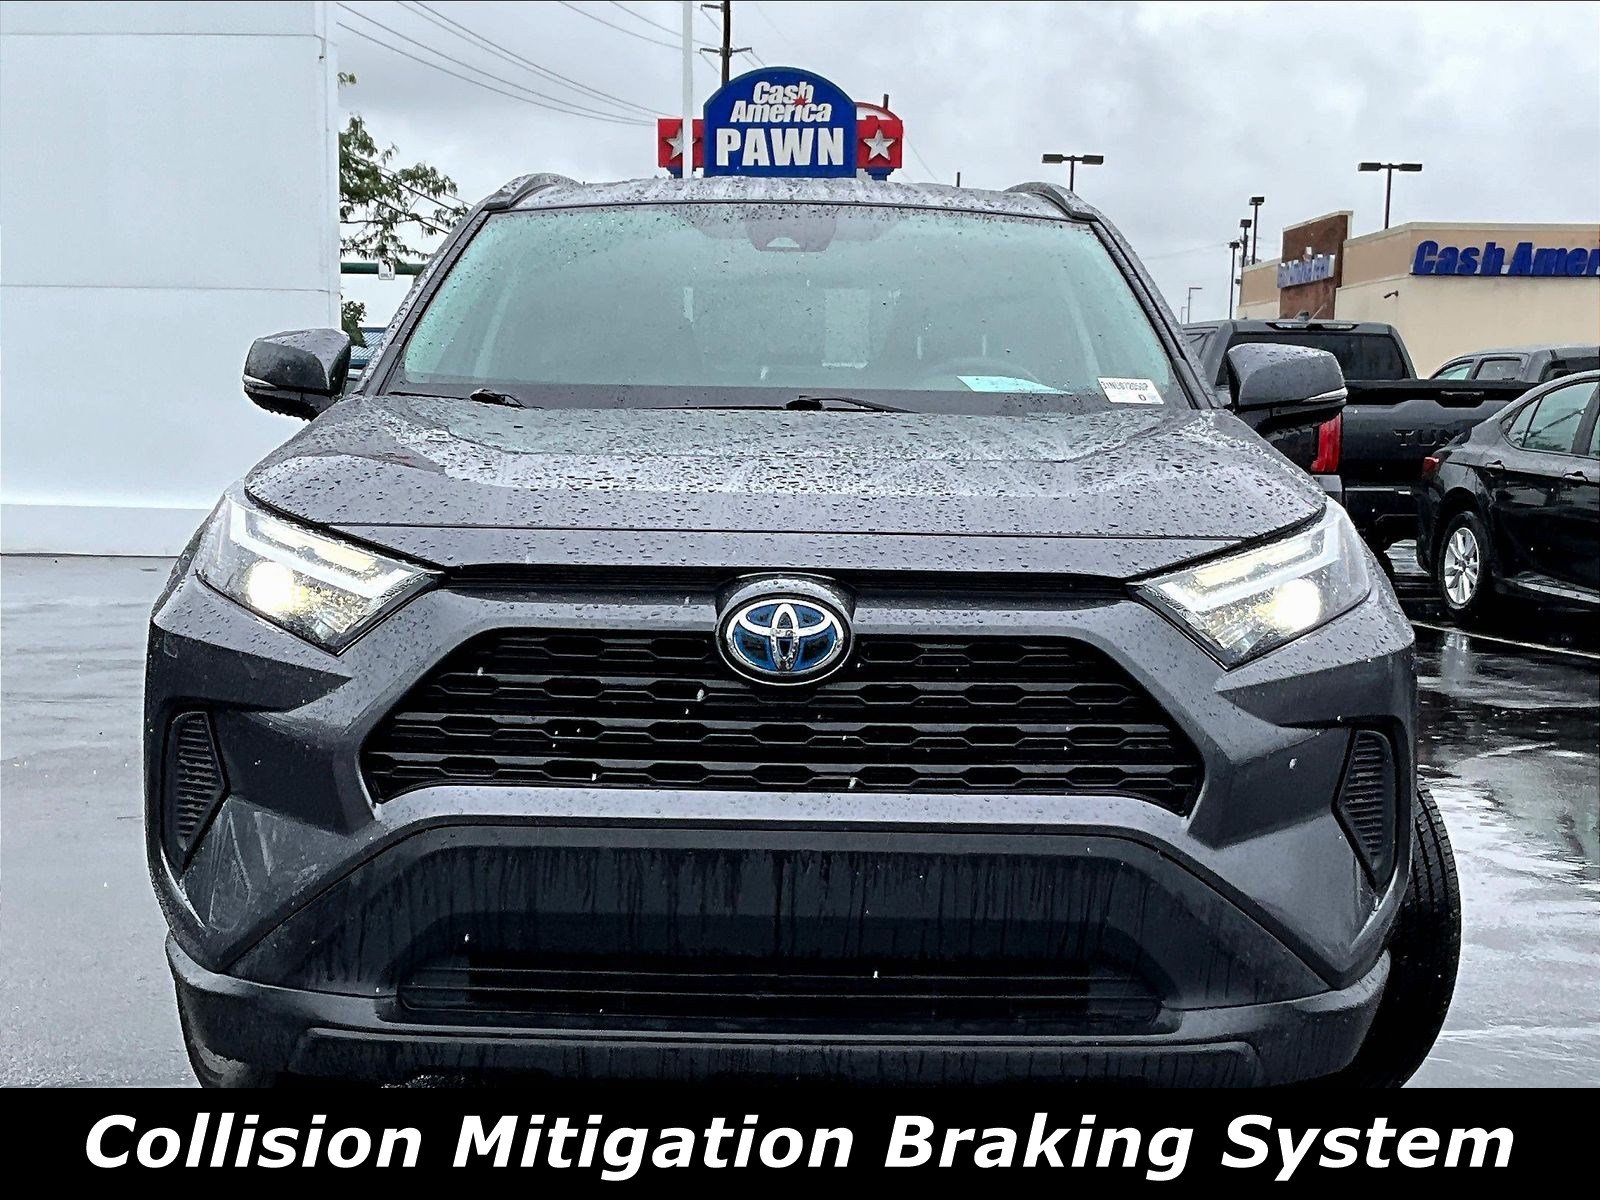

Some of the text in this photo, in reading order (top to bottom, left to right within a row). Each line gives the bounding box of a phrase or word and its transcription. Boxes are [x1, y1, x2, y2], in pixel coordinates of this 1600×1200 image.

[752, 81, 814, 104] Cash
[730, 100, 832, 123] America
[716, 127, 844, 166] PAWN
[1412, 240, 1506, 276] Cash
